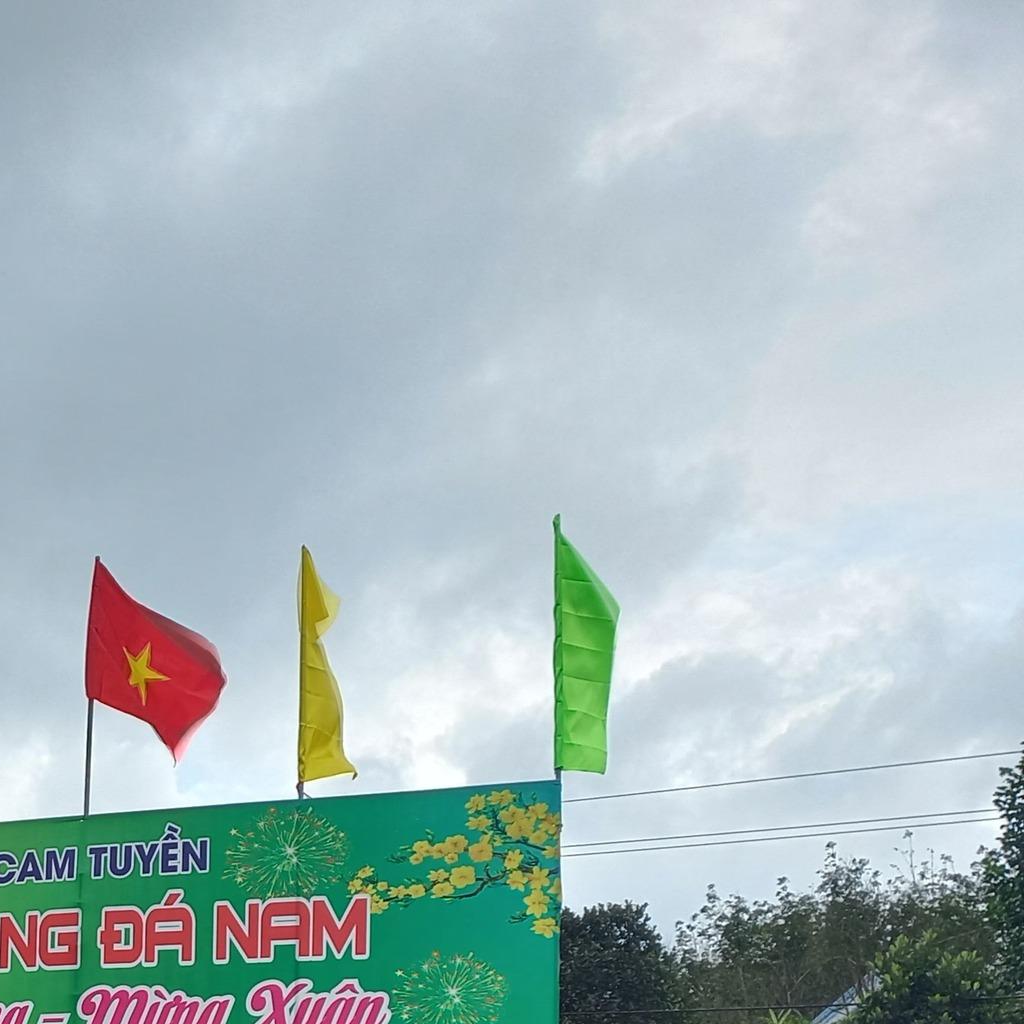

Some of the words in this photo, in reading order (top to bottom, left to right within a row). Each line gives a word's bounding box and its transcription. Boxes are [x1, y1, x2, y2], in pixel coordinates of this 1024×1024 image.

[89, 824, 209, 878] TUYỀN
[98, 889, 195, 967] ĐÁ
[213, 895, 370, 963] NAM
